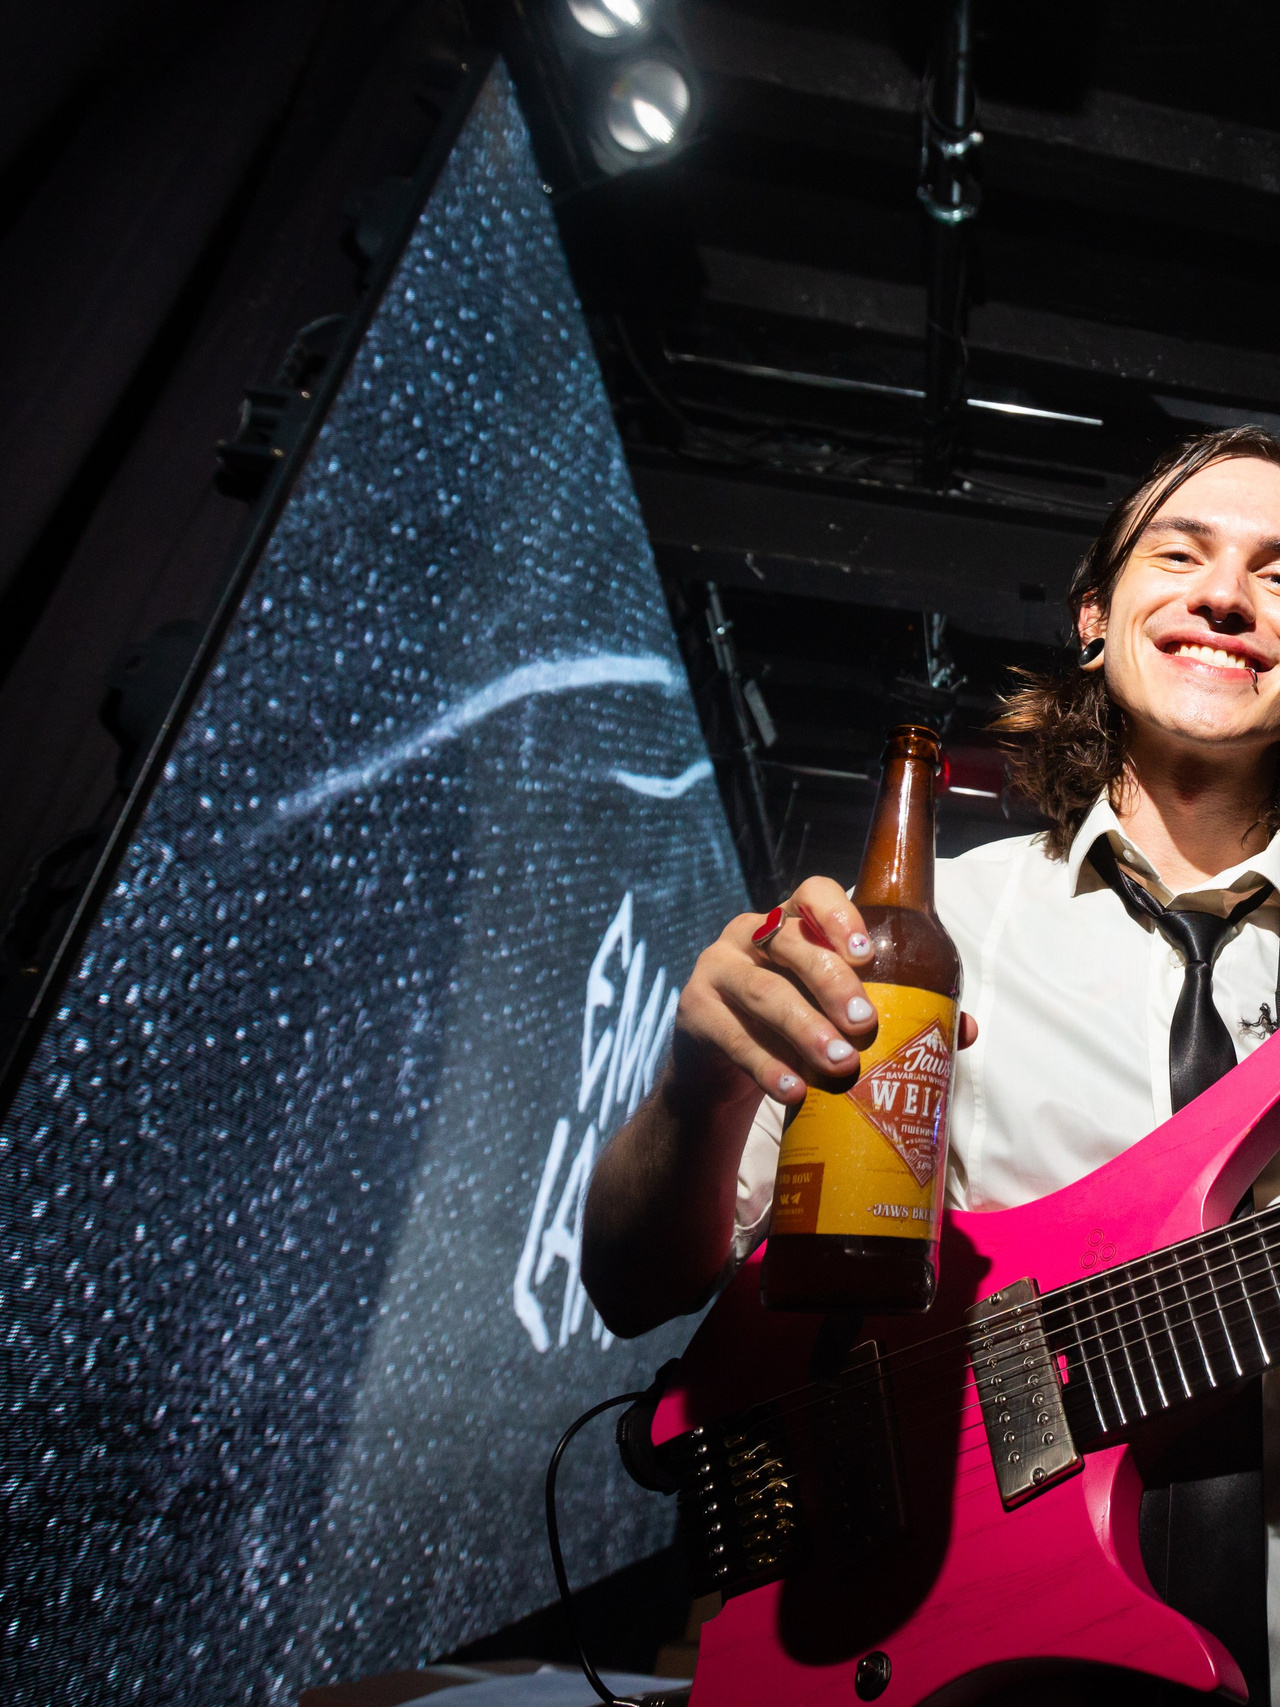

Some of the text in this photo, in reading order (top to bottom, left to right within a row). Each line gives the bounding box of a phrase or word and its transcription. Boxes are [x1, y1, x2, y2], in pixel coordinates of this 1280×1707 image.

[903, 1045, 951, 1078] Jaws
[886, 1071, 927, 1082] BAVARIAN
[872, 1202, 909, 1219] JAWS
